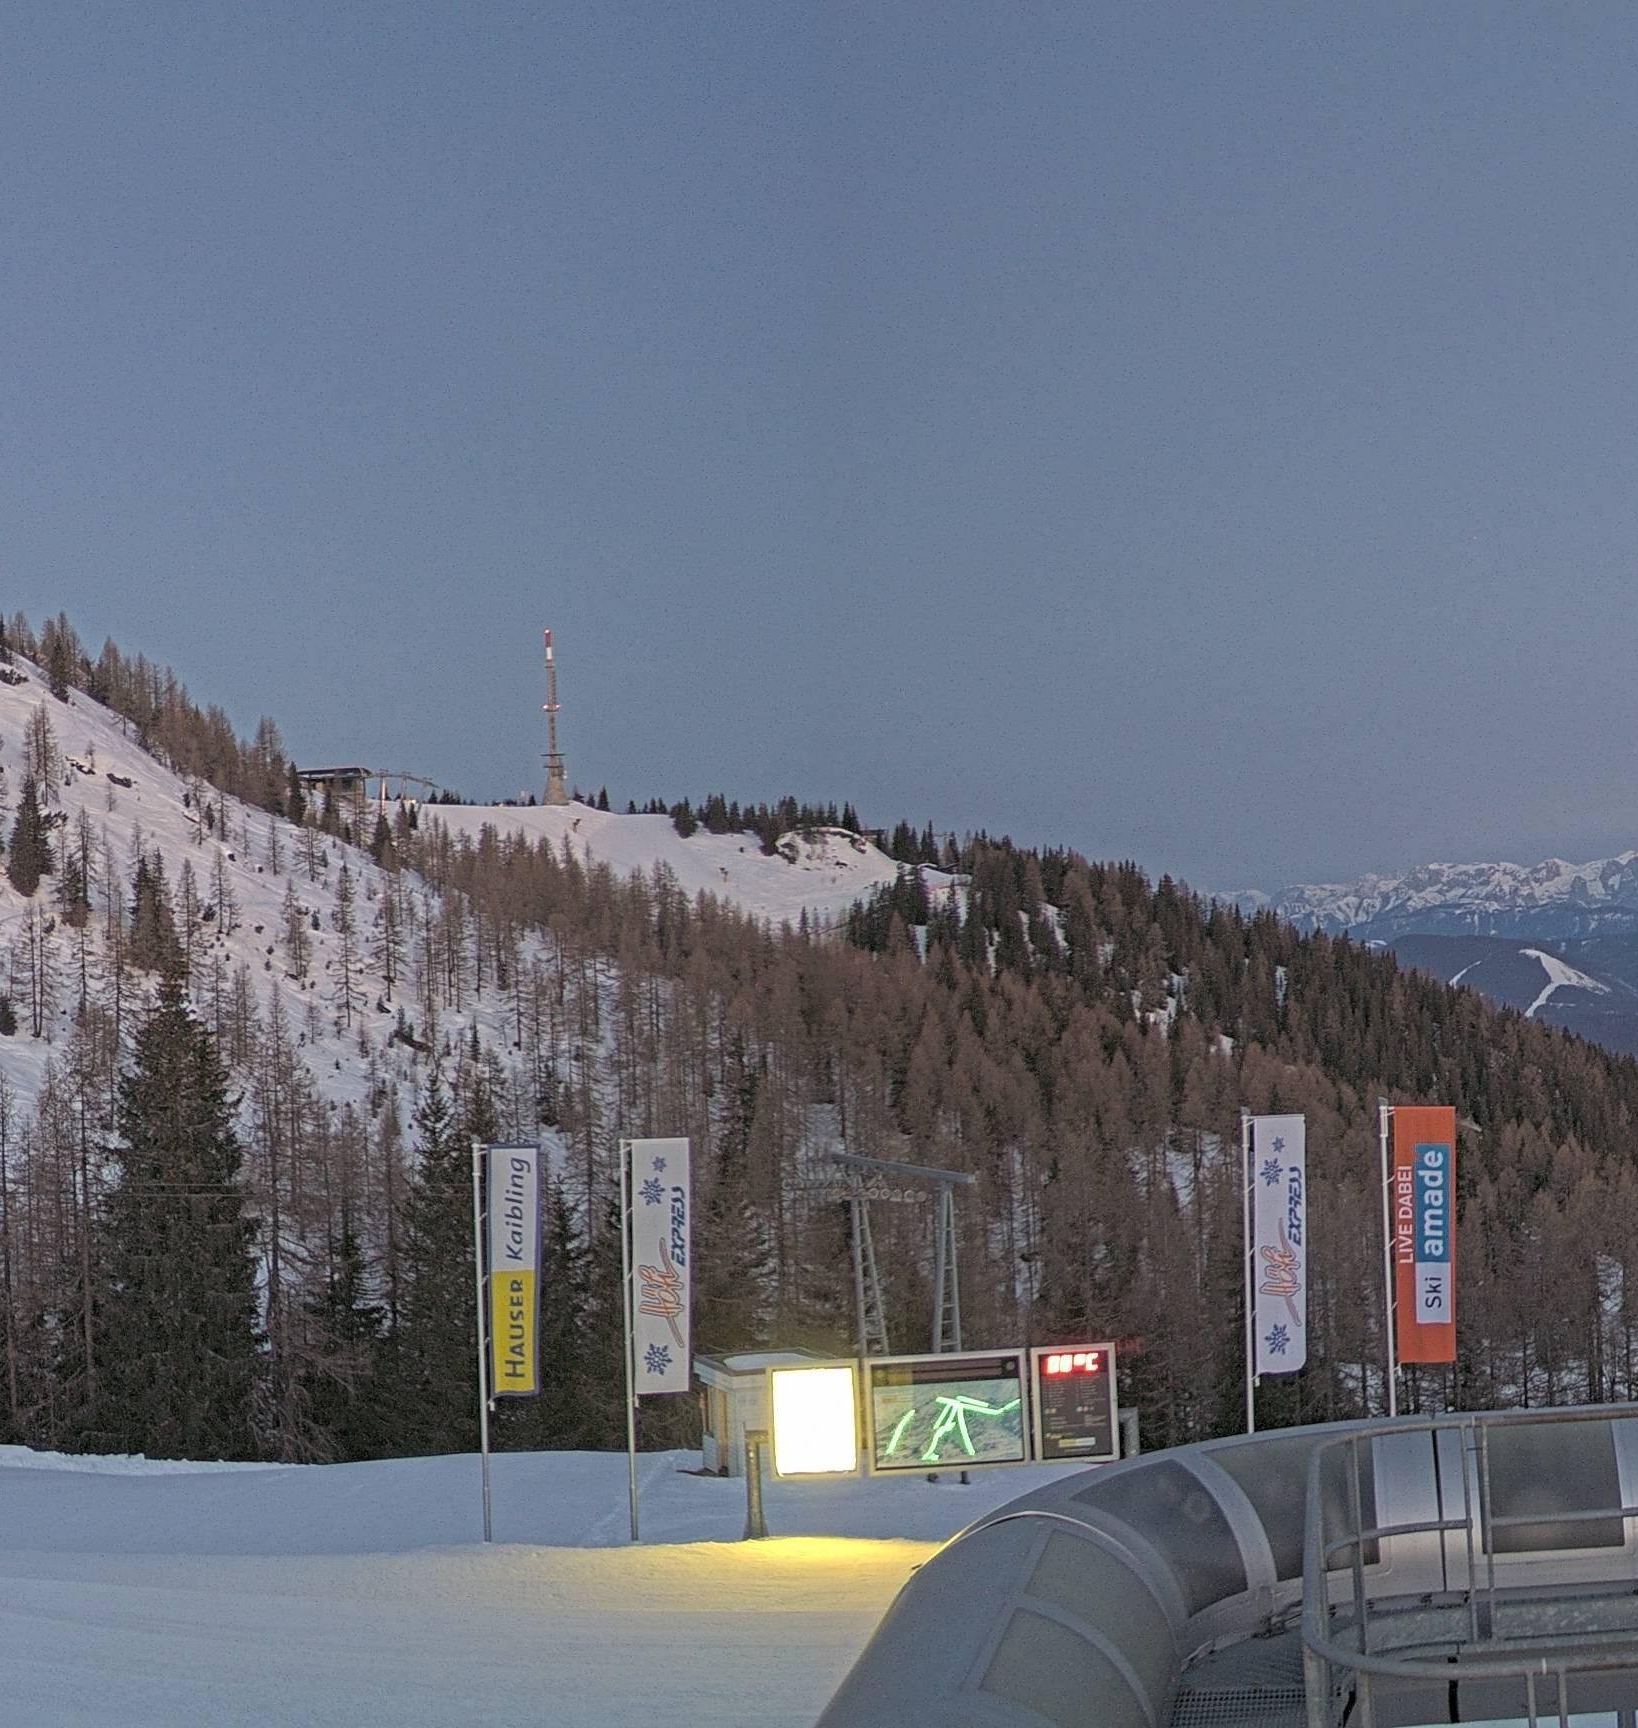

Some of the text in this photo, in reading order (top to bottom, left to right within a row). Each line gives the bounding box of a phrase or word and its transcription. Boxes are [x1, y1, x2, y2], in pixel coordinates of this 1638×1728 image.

[670, 1186, 686, 1267] EXPRESS
[1287, 1165, 1302, 1247] EXPRESS
[1398, 1165, 1414, 1264] LIVE DABEI
[504, 1157, 530, 1379] HAUSER Kaibling
[1425, 1276, 1442, 1309] Ski
